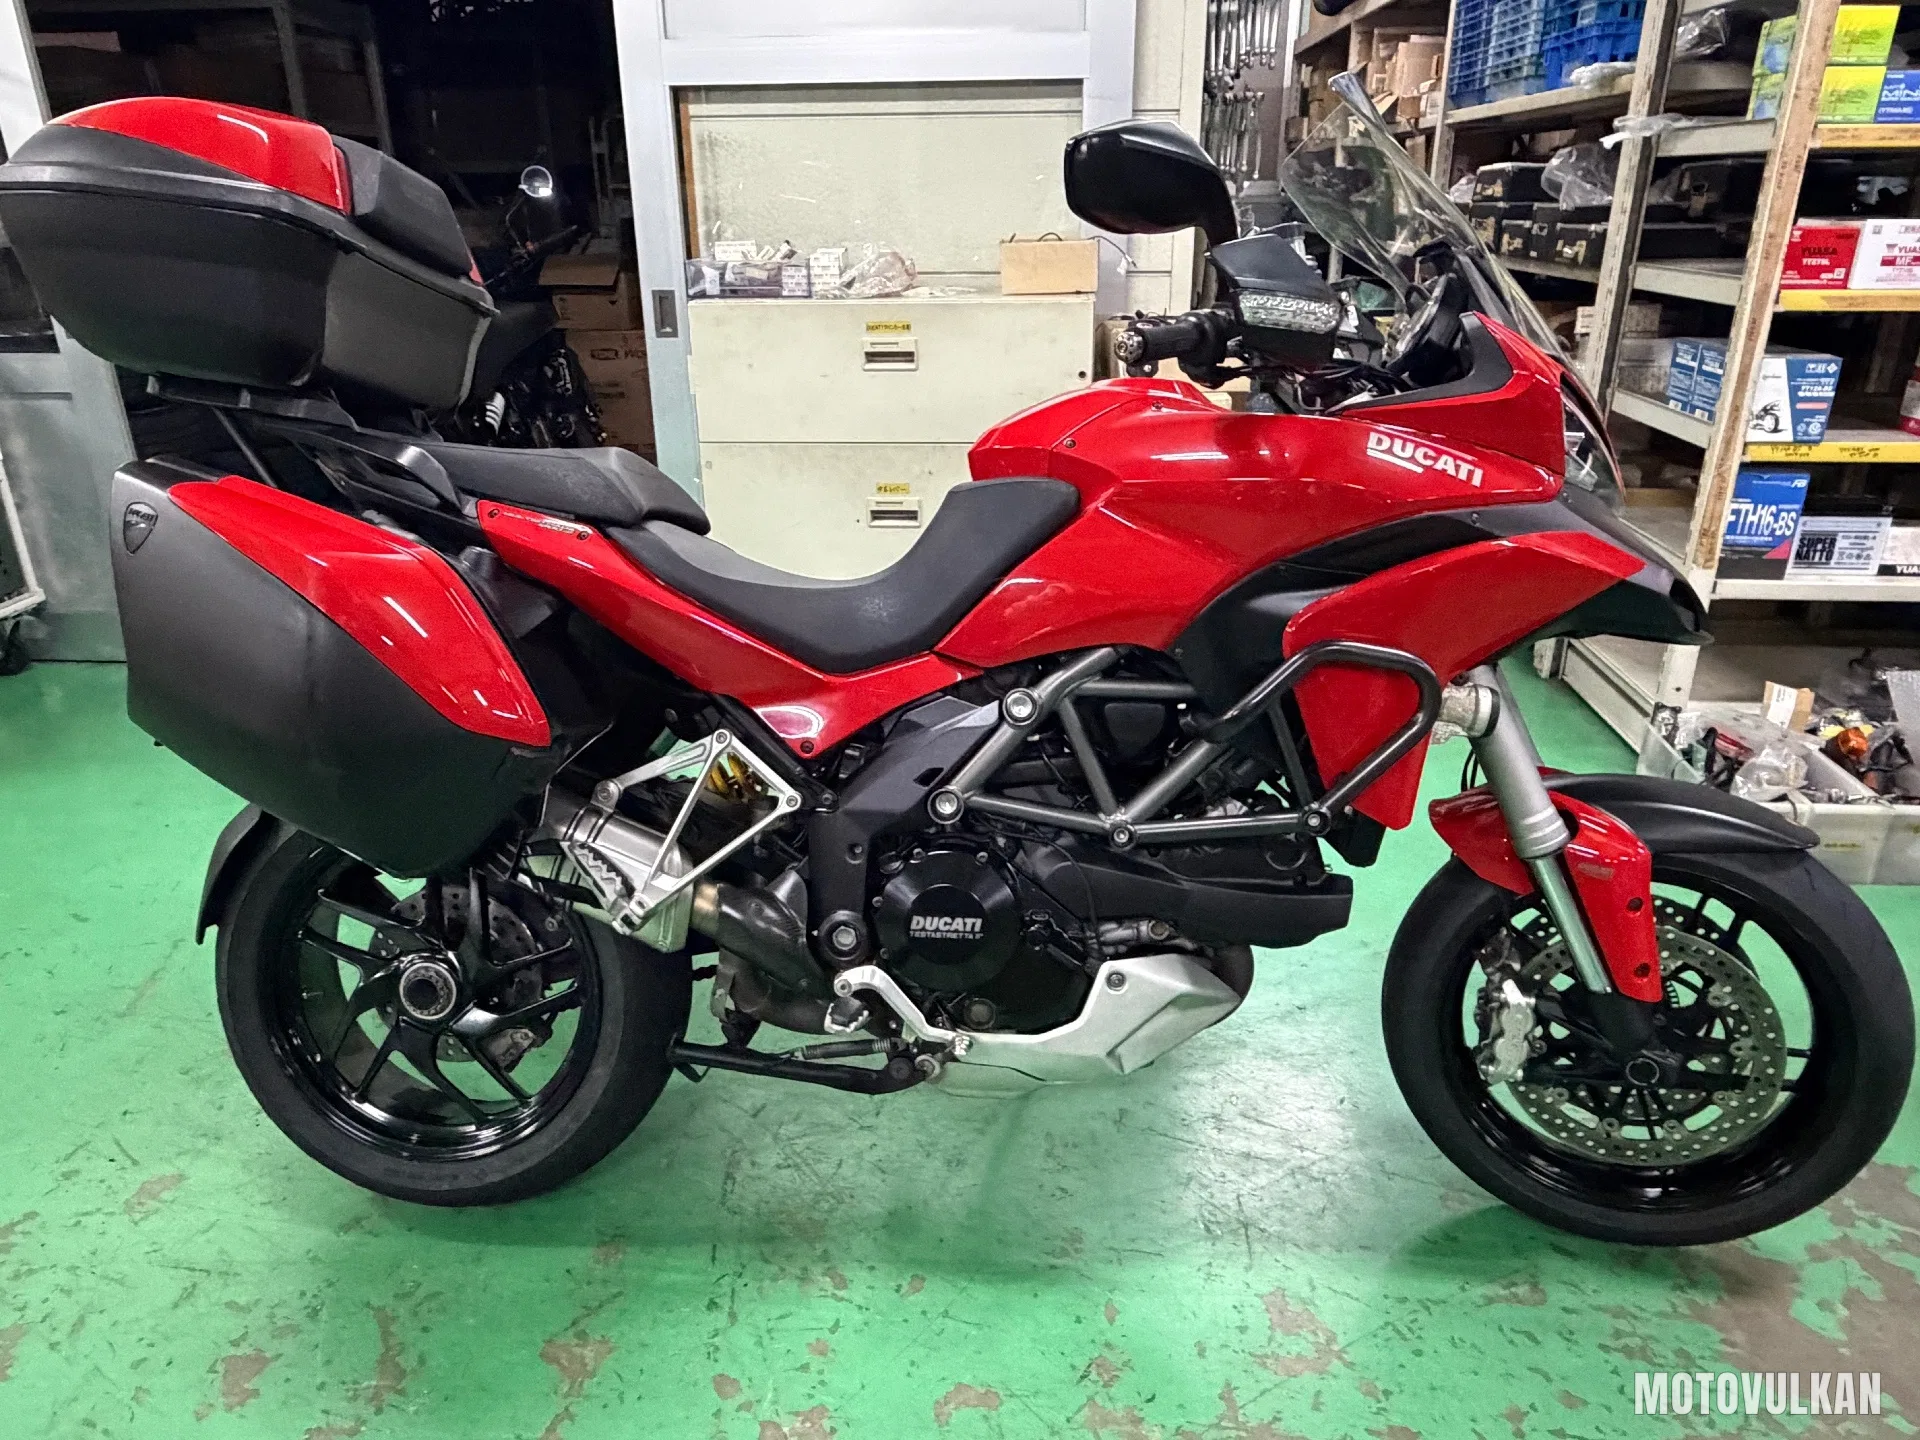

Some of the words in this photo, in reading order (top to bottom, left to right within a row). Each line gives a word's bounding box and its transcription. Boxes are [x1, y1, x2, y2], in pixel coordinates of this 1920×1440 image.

[1366, 431, 1484, 488] DUCATI
[1725, 503, 1797, 536] FTH16-BS
[1797, 536, 1838, 550] SUPER
[1794, 548, 1835, 562] NATTO
[1896, 564, 1920, 574] YUA
[910, 915, 983, 931] DUCATI
